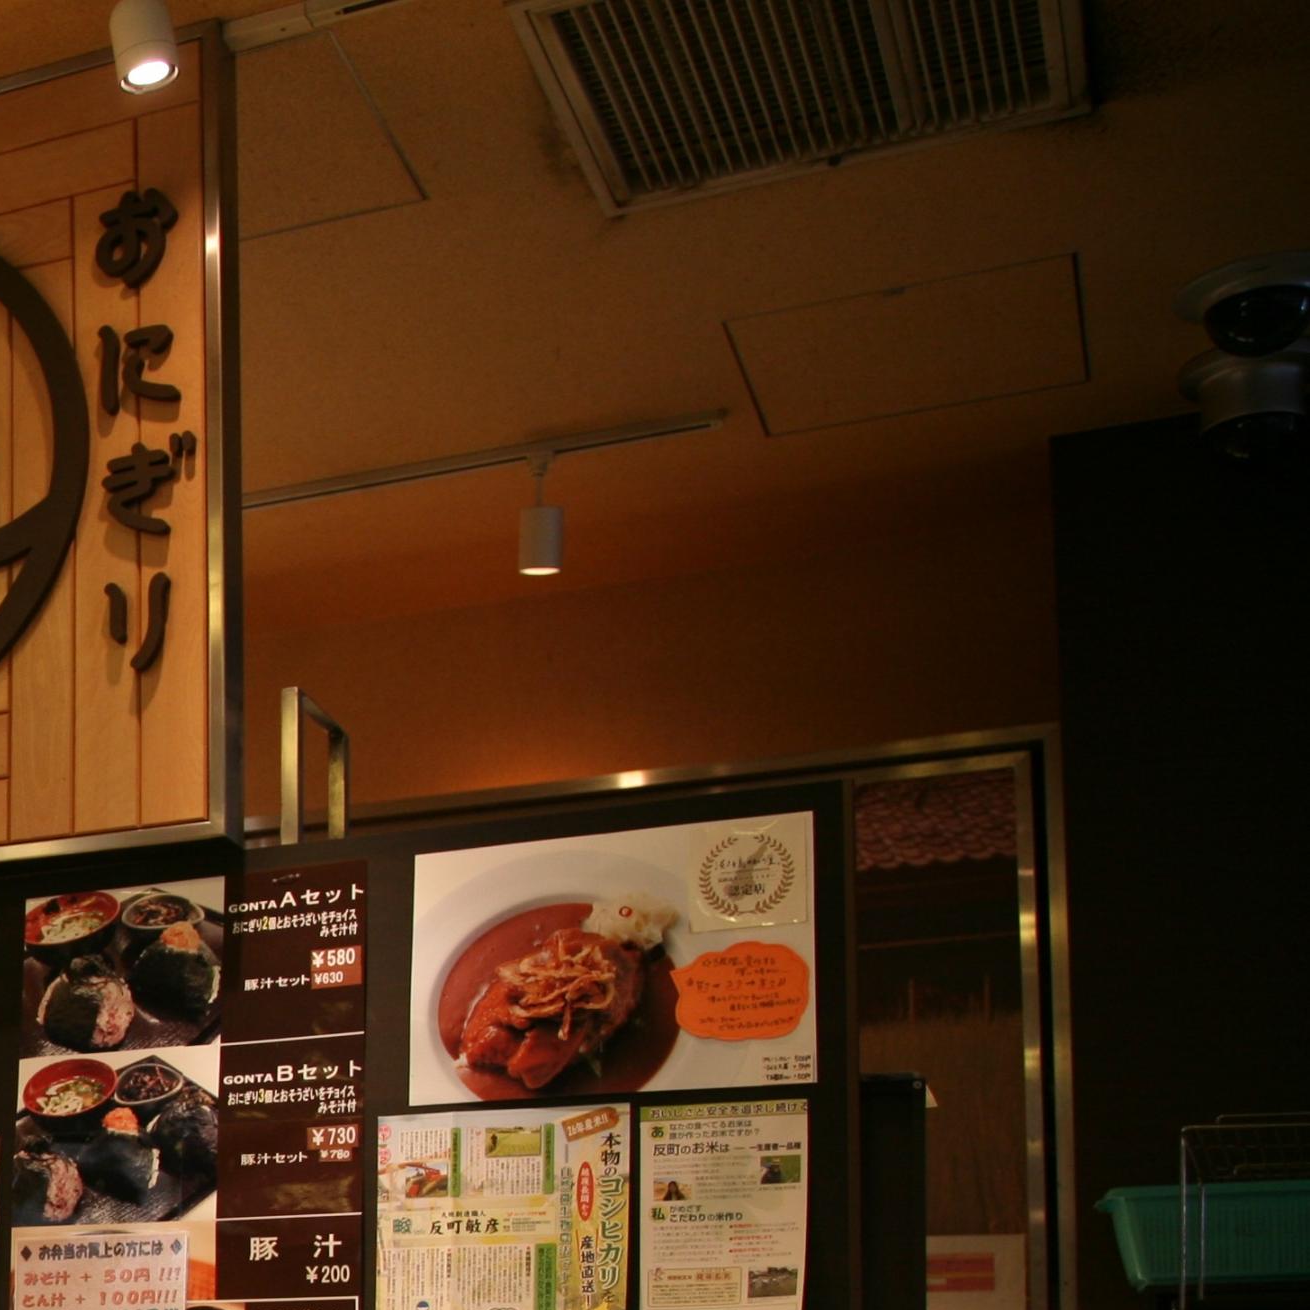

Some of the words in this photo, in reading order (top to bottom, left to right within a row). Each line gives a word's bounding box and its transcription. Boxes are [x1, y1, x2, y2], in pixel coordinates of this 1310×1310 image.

[95, 188, 197, 672] おにぎり
[228, 899, 277, 914] GONTA
[280, 883, 364, 908] Aセット
[319, 921, 358, 937] みそ汁付
[311, 947, 355, 968] ¥580
[244, 974, 310, 991] 豚汁セット
[223, 1073, 274, 1085] GONTA
[277, 1059, 362, 1082] Bセット
[317, 1099, 357, 1114] みそ汁付
[312, 1126, 356, 1146] ¥730
[240, 1151, 308, 1166] 豚汁セット
[305, 1264, 350, 1284] ¥200
